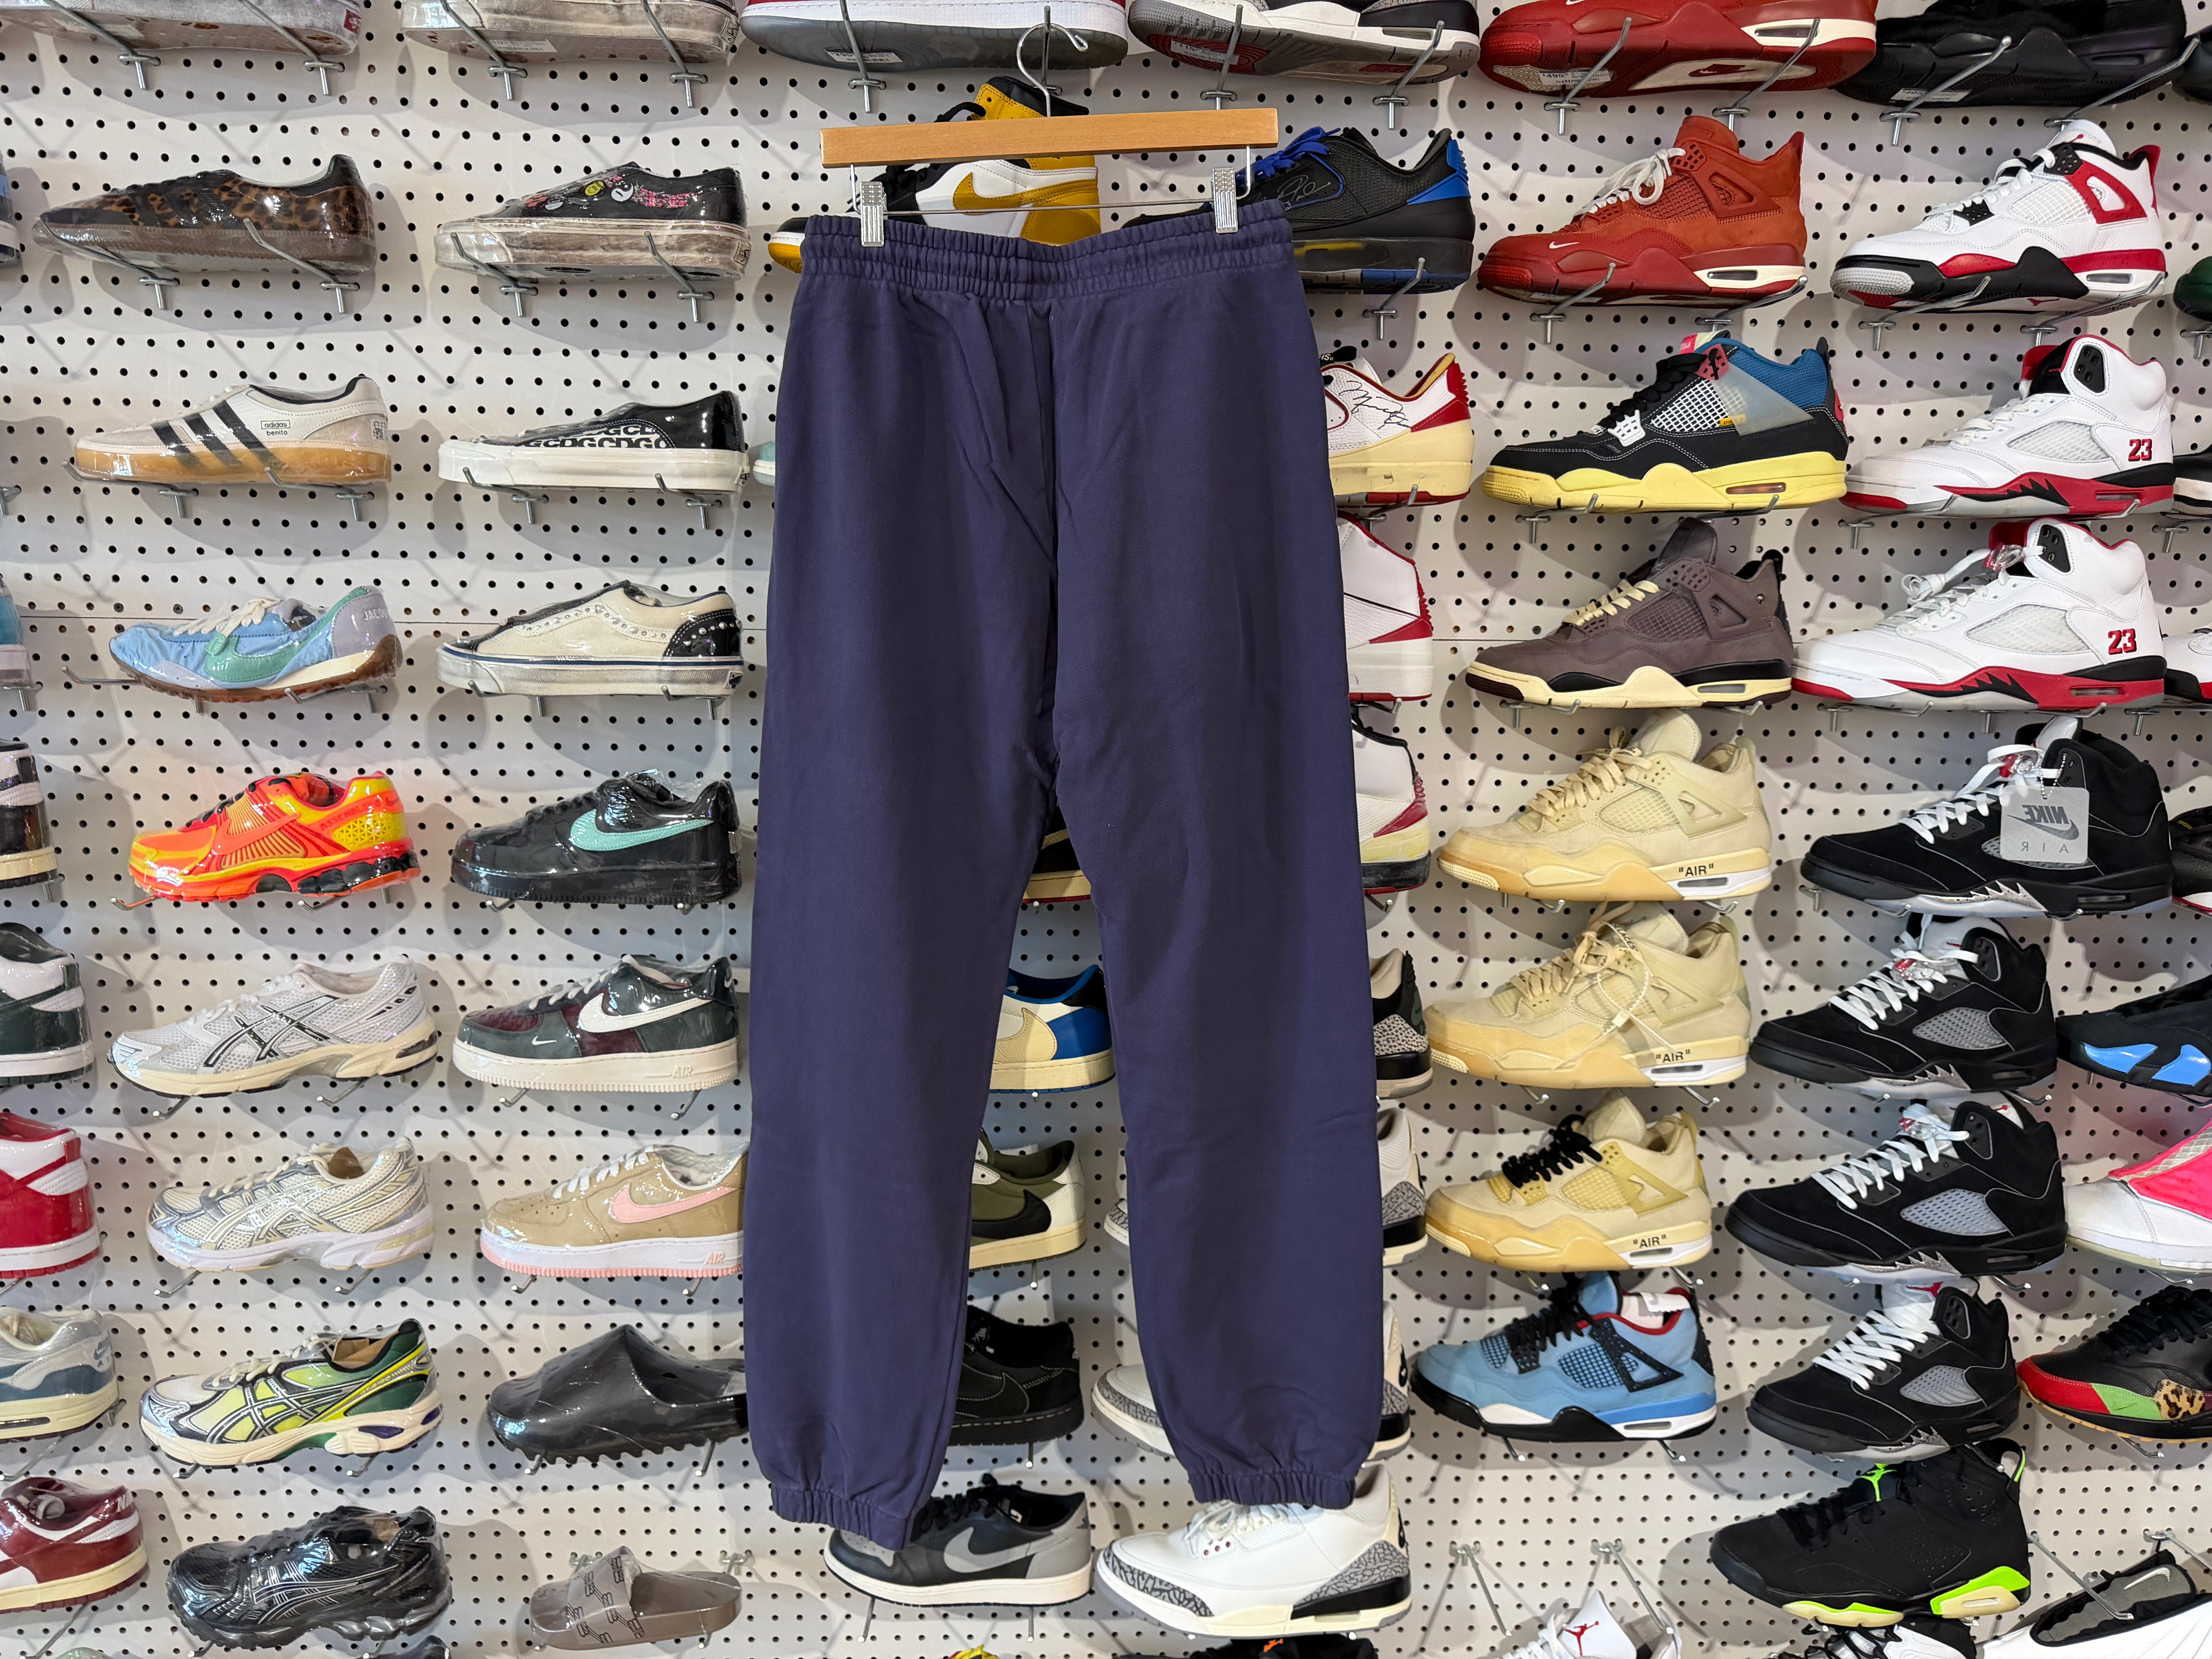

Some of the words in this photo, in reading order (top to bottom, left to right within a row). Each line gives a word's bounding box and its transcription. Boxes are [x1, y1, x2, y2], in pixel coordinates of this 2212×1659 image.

[2128, 438, 2152, 462] 23
[2107, 628, 2137, 655] 23
[672, 1065, 693, 1079] AIR
[705, 1252, 725, 1264] AIR
